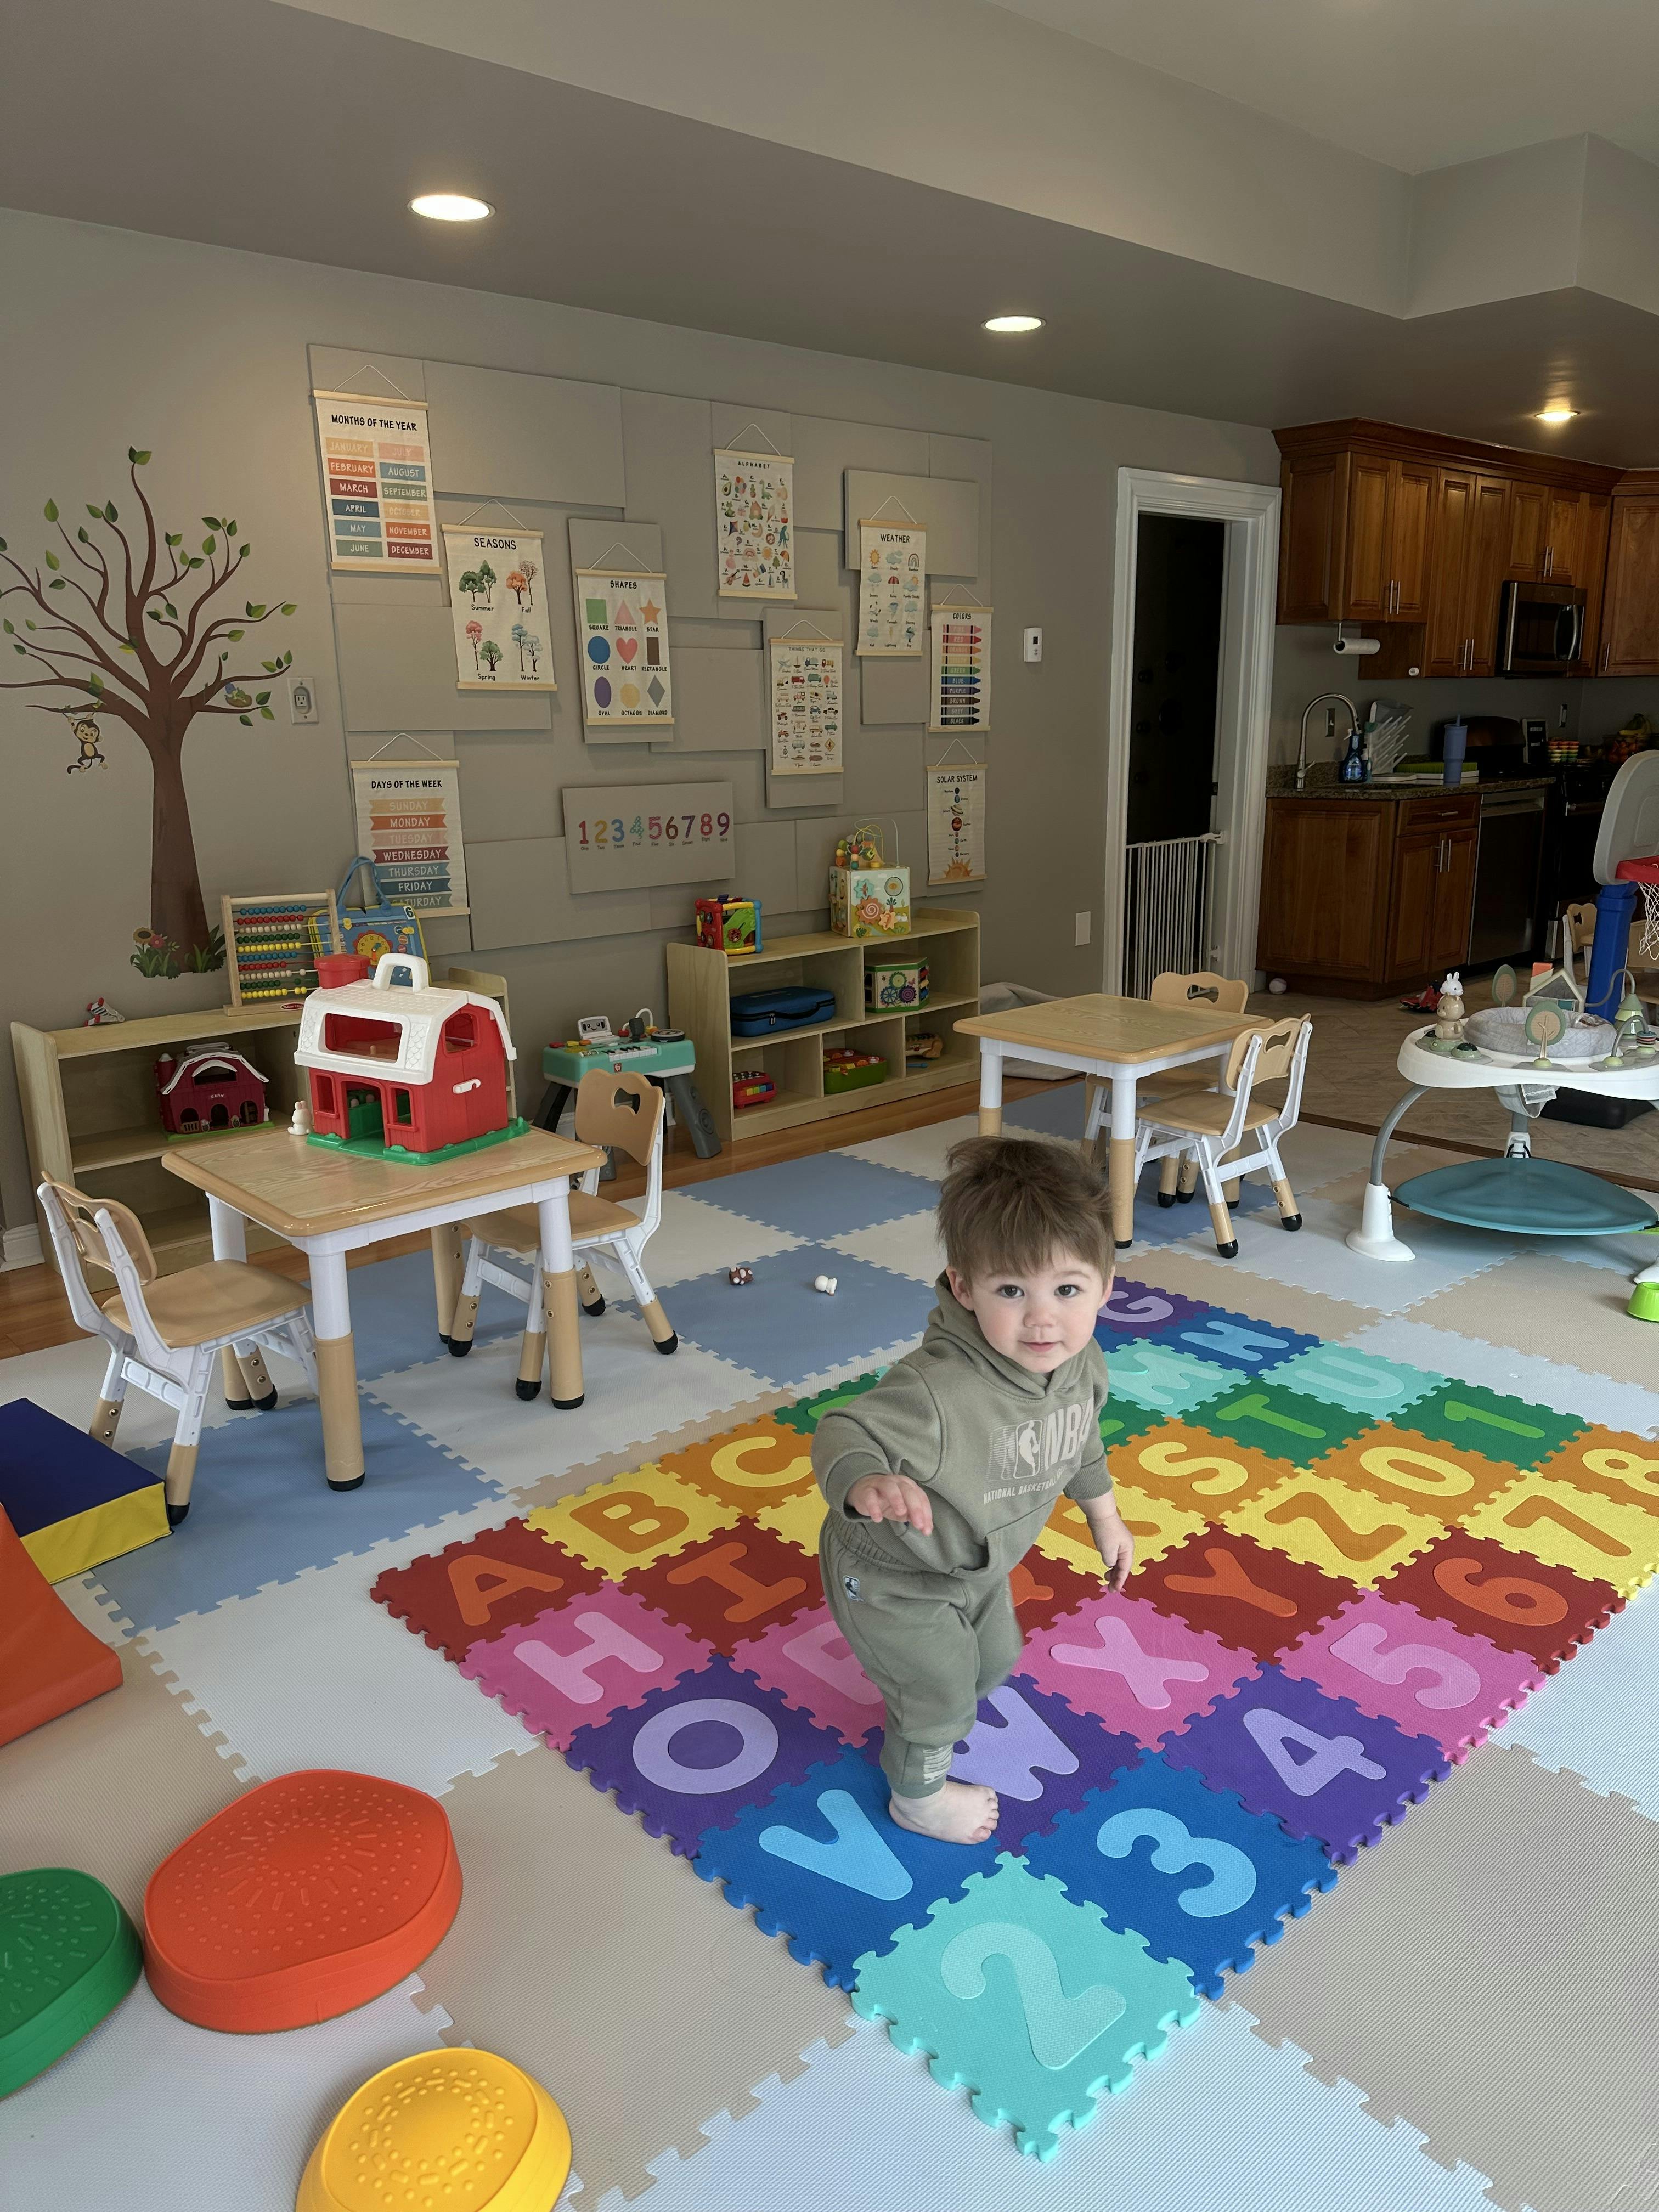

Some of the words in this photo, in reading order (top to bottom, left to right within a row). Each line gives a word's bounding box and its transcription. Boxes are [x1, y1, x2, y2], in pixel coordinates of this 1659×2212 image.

[331, 414, 365, 426] MONTHS
[368, 417, 377, 427] OF
[379, 419, 394, 429] THE
[396, 421, 417, 431] YEAR
[330, 442, 368, 453] JANUARY
[392, 447, 411, 457] JULY
[330, 462, 374, 473] FEBRUARY
[388, 467, 419, 477] AUGUST
[340, 483, 368, 493] MARCH
[383, 487, 427, 498] SEPTEMBER
[346, 504, 366, 514] APRIL
[389, 507, 420, 517] OCTOBER
[350, 524, 366, 533] MAY
[389, 526, 428, 536] NOVEMBER
[474, 538, 516, 550] SEASONS
[881, 534, 910, 543] WEATHER
[351, 544, 369, 552] JUNE
[391, 546, 429, 555] DECEMBER
[610, 580, 637, 589] SHAPES
[471, 603, 494, 612] Summer
[371, 781, 392, 789] DAYS
[422, 780, 442, 788] WEEK
[390, 802, 428, 811] SUNDAY
[390, 817, 430, 828] MONDAY
[579, 821, 589, 844] 1
[594, 820, 608, 843] 2
[611, 819, 624, 842] 3
[630, 816, 644, 839] 4
[648, 816, 662, 840] 5
[665, 816, 679, 840] 6
[681, 815, 696, 838] 7
[700, 813, 713, 836] 8
[717, 812, 730, 836] 9
[389, 834, 434, 844] TUESDAY
[383, 849, 441, 861] WEDNESDAY
[388, 866, 439, 877] THURSDAY
[399, 882, 432, 891] FRIDAY
[406, 907, 414, 918] 6
[1099, 1291, 1173, 1322] G
[1296, 1356, 1404, 1398] U
[1216, 1394, 1325, 1438] T
[1444, 1400, 1545, 1438] 1
[1045, 1396, 1094, 1471] NBA
[710, 1436, 814, 1487] C
[1139, 1442, 1248, 1495] S
[1582, 1448, 1659, 1497] 8
[984, 1487, 1015, 1504] NATIONAL
[1018, 1480, 1057, 1496] BASKETBALL
[569, 1491, 689, 1554] B
[1265, 1491, 1407, 1562] Z
[1503, 1494, 1632, 1556] 7
[447, 1554, 565, 1626] A
[666, 1542, 807, 1622] I
[1164, 1548, 1297, 1617] Y
[1432, 1558, 1568, 1625] 6
[514, 1611, 664, 1704] H
[1050, 1616, 1209, 1710] X
[1329, 1623, 1481, 1710] 5
[1243, 1708, 1386, 1796] 4
[758, 1788, 913, 1901] V
[1097, 1808, 1257, 1917] 3
[940, 1921, 1126, 2070] 2
